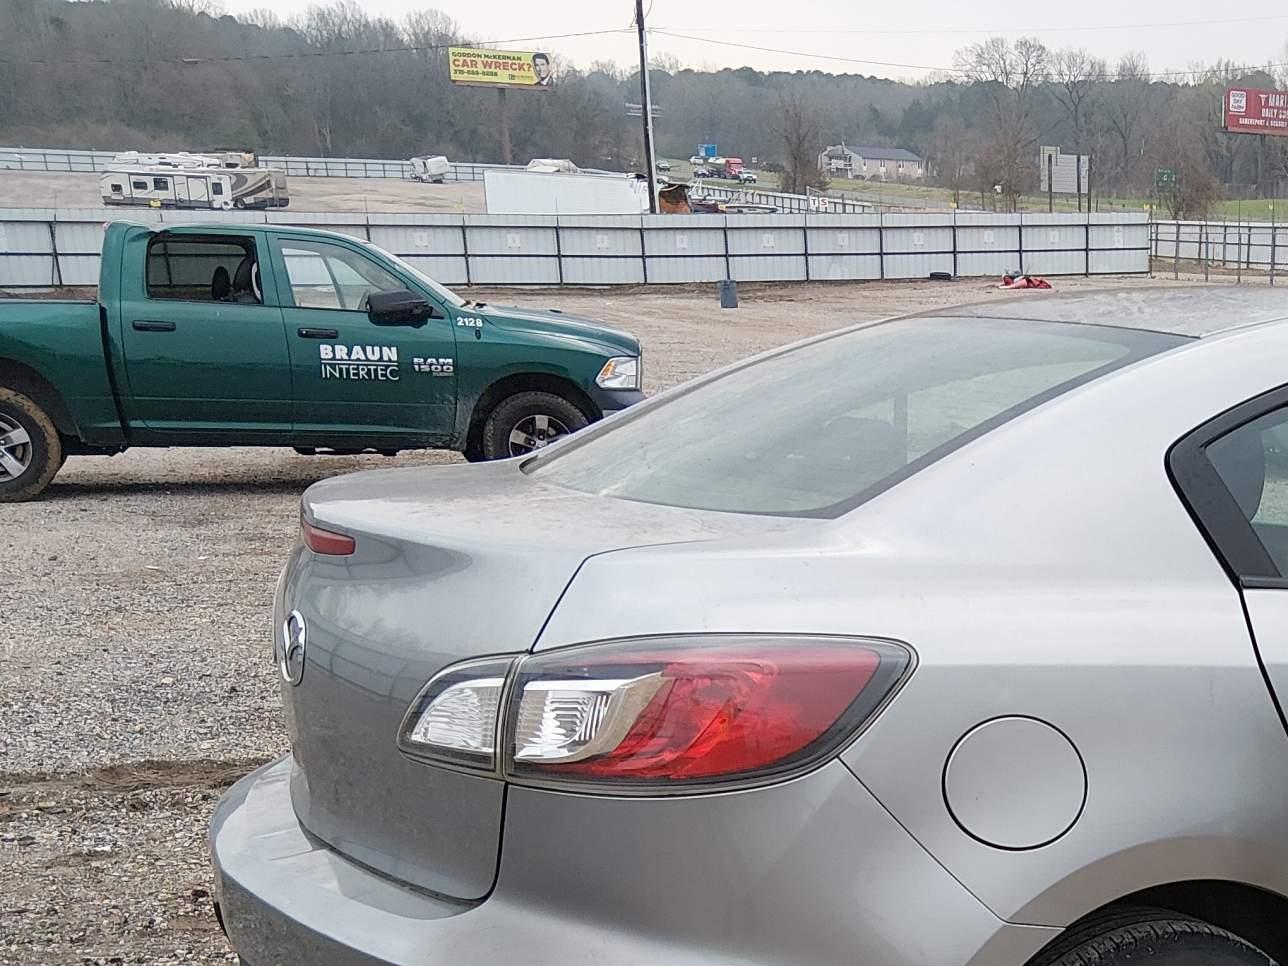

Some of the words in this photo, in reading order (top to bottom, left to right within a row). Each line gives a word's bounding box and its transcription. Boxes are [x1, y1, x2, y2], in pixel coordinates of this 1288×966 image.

[452, 51, 482, 59] GORDON
[452, 59, 479, 69] CAR
[482, 60, 532, 72] WRECK?
[1261, 108, 1278, 118] DAILY
[457, 317, 483, 327] 2128
[319, 344, 398, 361] BRAUN
[413, 357, 453, 365] RAM
[321, 364, 400, 381] INTERTEC
